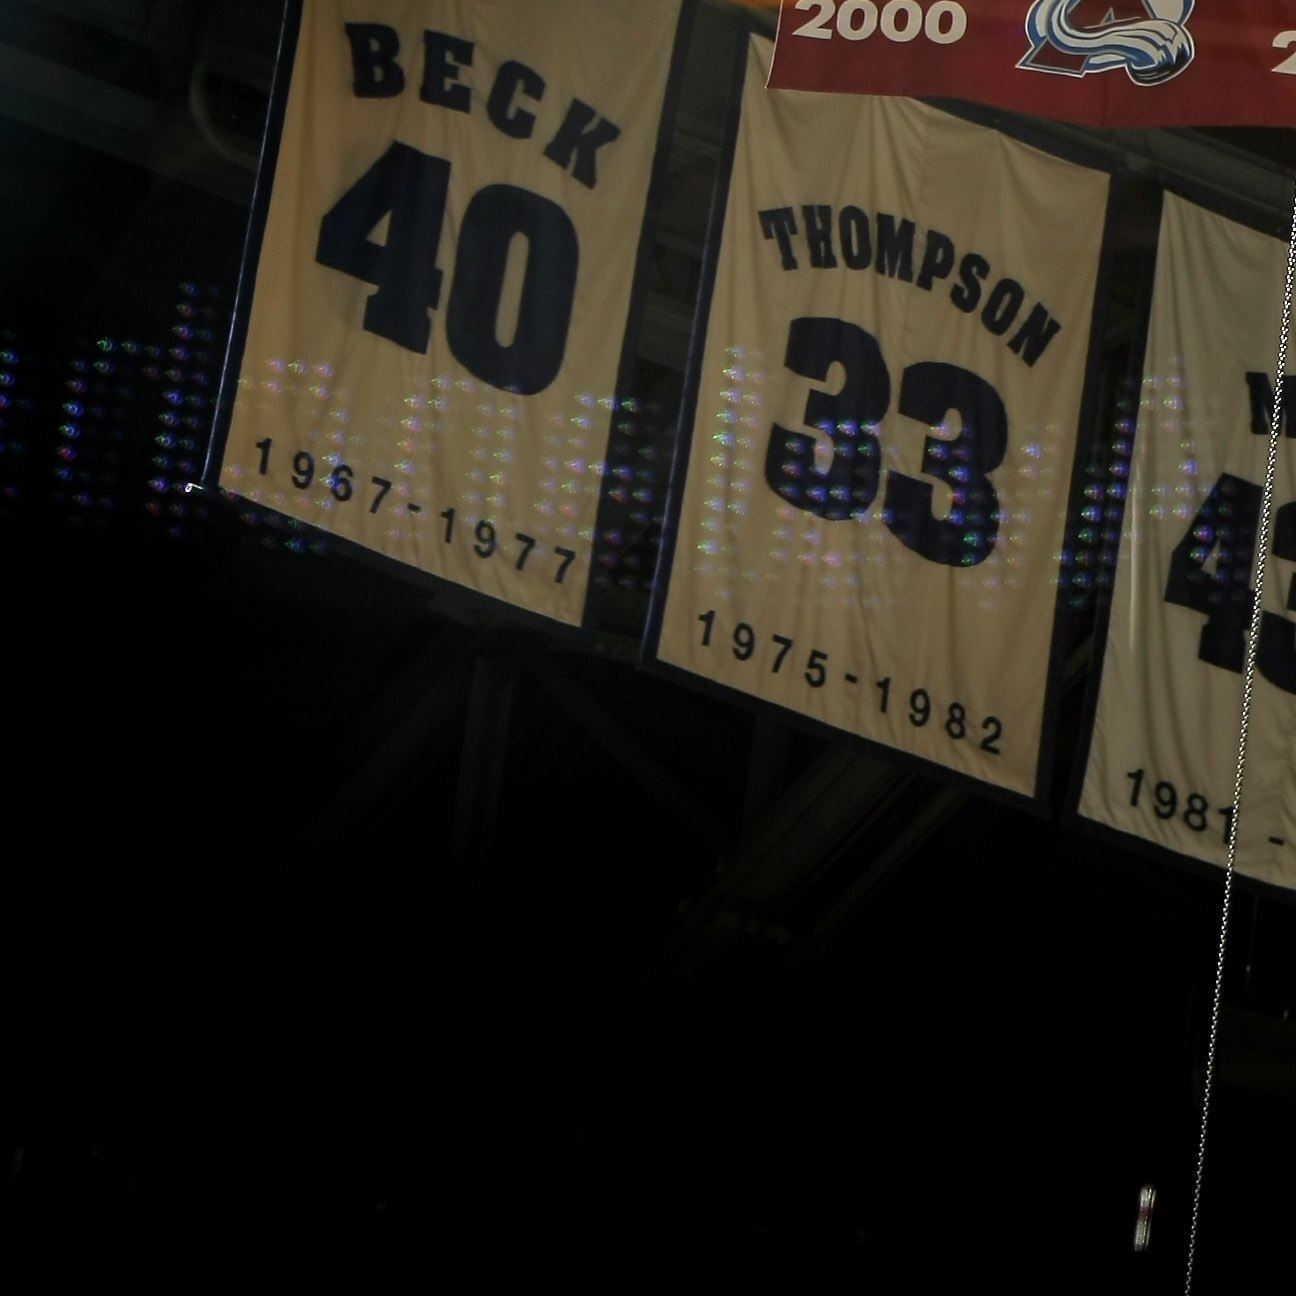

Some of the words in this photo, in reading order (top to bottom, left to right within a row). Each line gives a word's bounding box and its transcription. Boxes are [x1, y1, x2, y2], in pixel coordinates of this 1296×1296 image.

[344, 22, 621, 190] BECK
[315, 139, 580, 396] 40
[758, 204, 1061, 367] THOMPSON
[254, 437, 576, 584] 1967-1977
[764, 316, 1008, 568] 33
[698, 609, 1002, 756] 1975-1982
